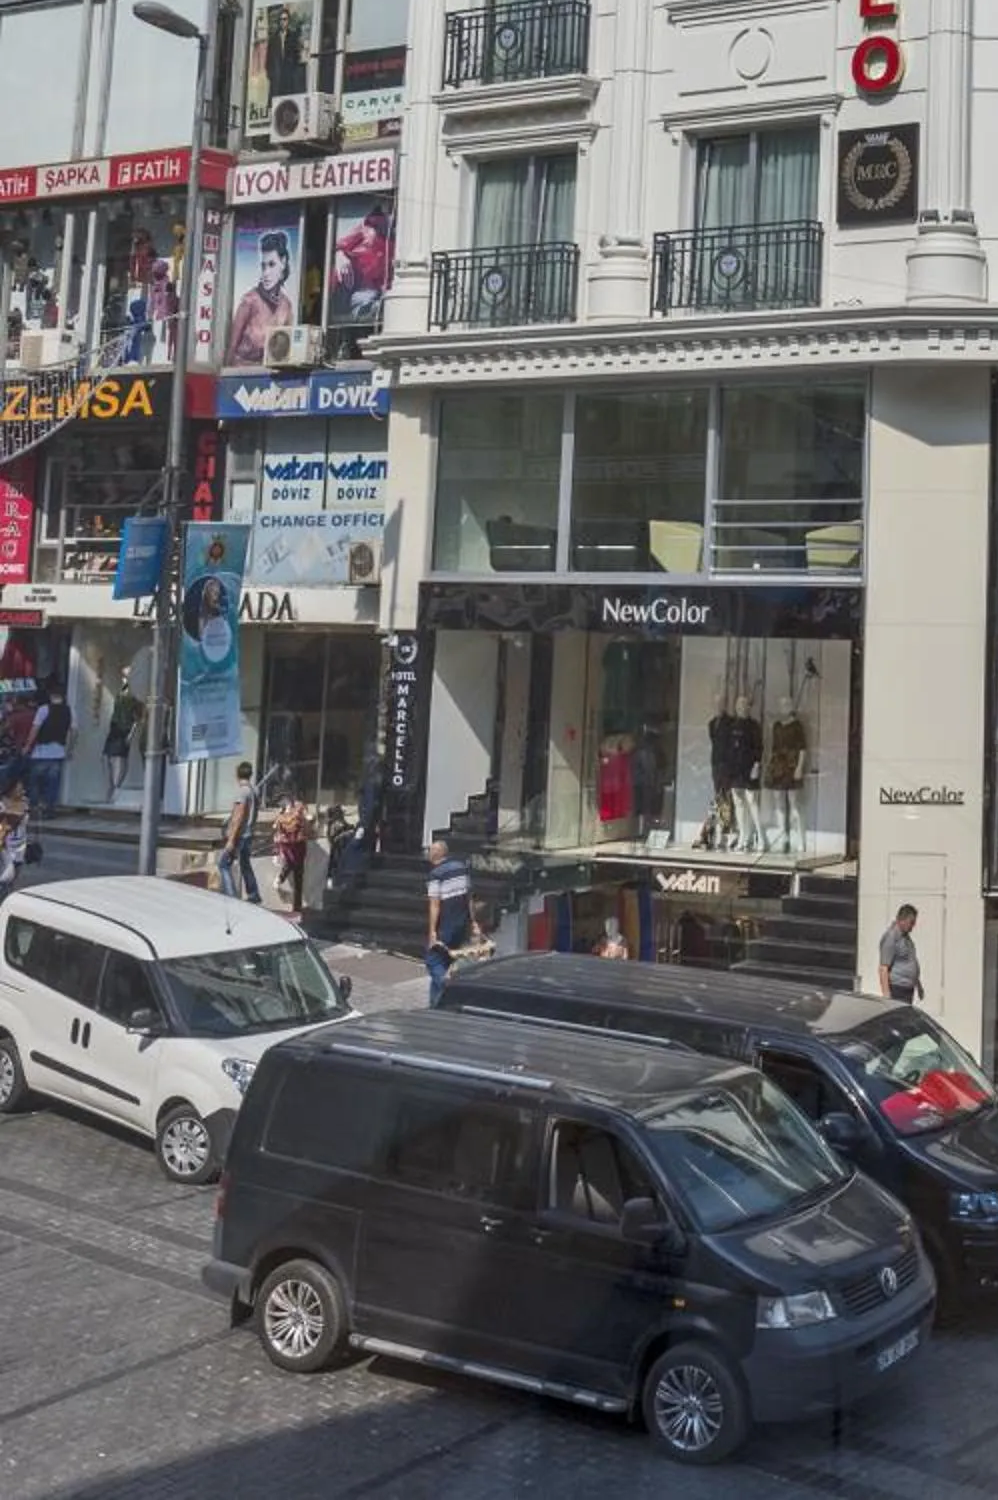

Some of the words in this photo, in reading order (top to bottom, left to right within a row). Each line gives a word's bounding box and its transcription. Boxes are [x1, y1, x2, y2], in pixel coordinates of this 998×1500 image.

[235, 167, 290, 197] LYON
[301, 158, 391, 190] LEATHER
[260, 514, 328, 528] CHANGE
[602, 597, 711, 624] NewColor
[392, 684, 409, 786] MARCELLO
[879, 786, 964, 805] NewColor
